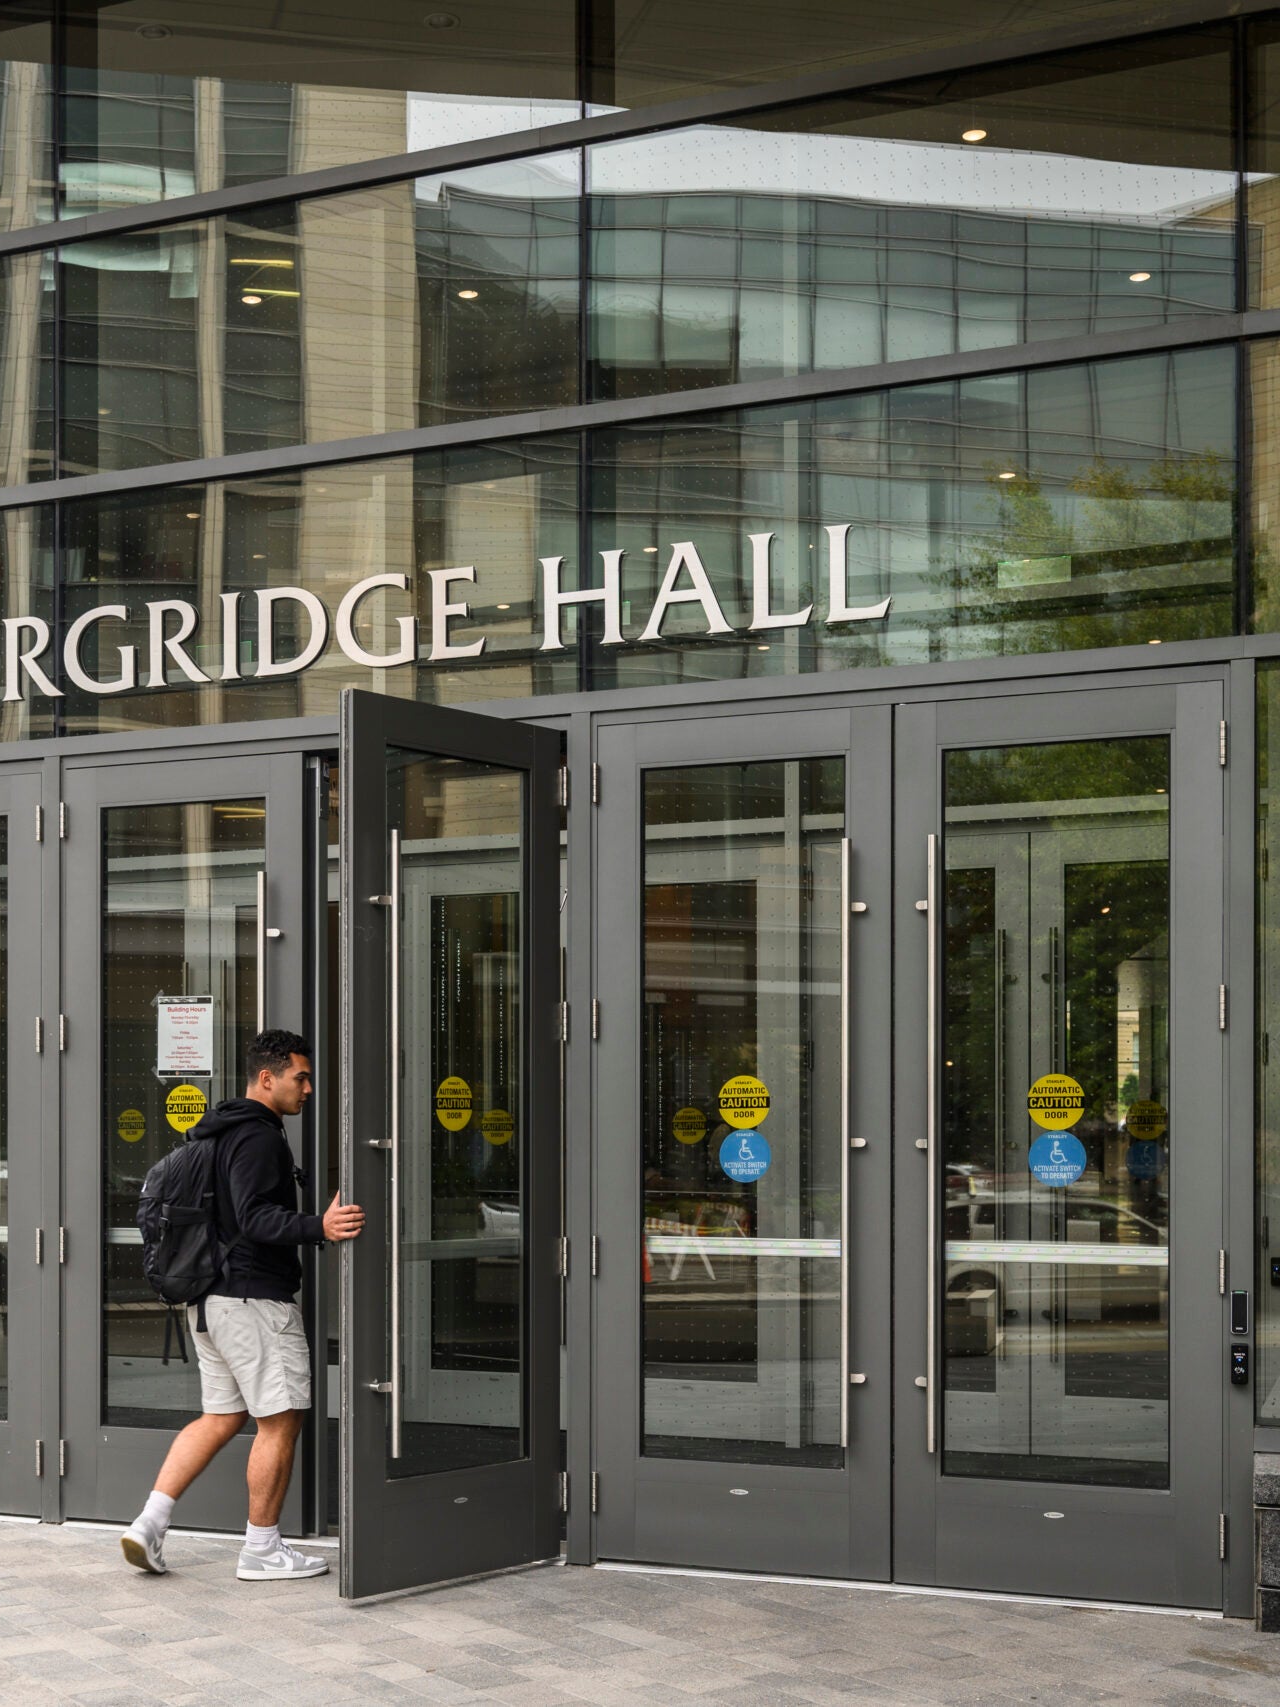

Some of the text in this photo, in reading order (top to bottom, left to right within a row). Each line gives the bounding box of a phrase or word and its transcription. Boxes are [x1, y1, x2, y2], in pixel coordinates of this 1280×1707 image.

[538, 524, 892, 651] HALL
[439, 1088, 470, 1096] AUTOMATIC
[722, 1087, 766, 1095] AUTOMATIC
[1031, 1086, 1080, 1095] AUTOMATIC
[437, 1098, 471, 1108] CAUTION
[720, 1097, 767, 1108] CAUTION
[1029, 1097, 1082, 1108] CAUTION
[166, 1103, 205, 1113] CAUTION
[1044, 1111, 1068, 1119] DOOR
[482, 1122, 513, 1131] CAUTION
[672, 1121, 706, 1130] CAUTION
[723, 1161, 748, 1169] ACTIVATE
